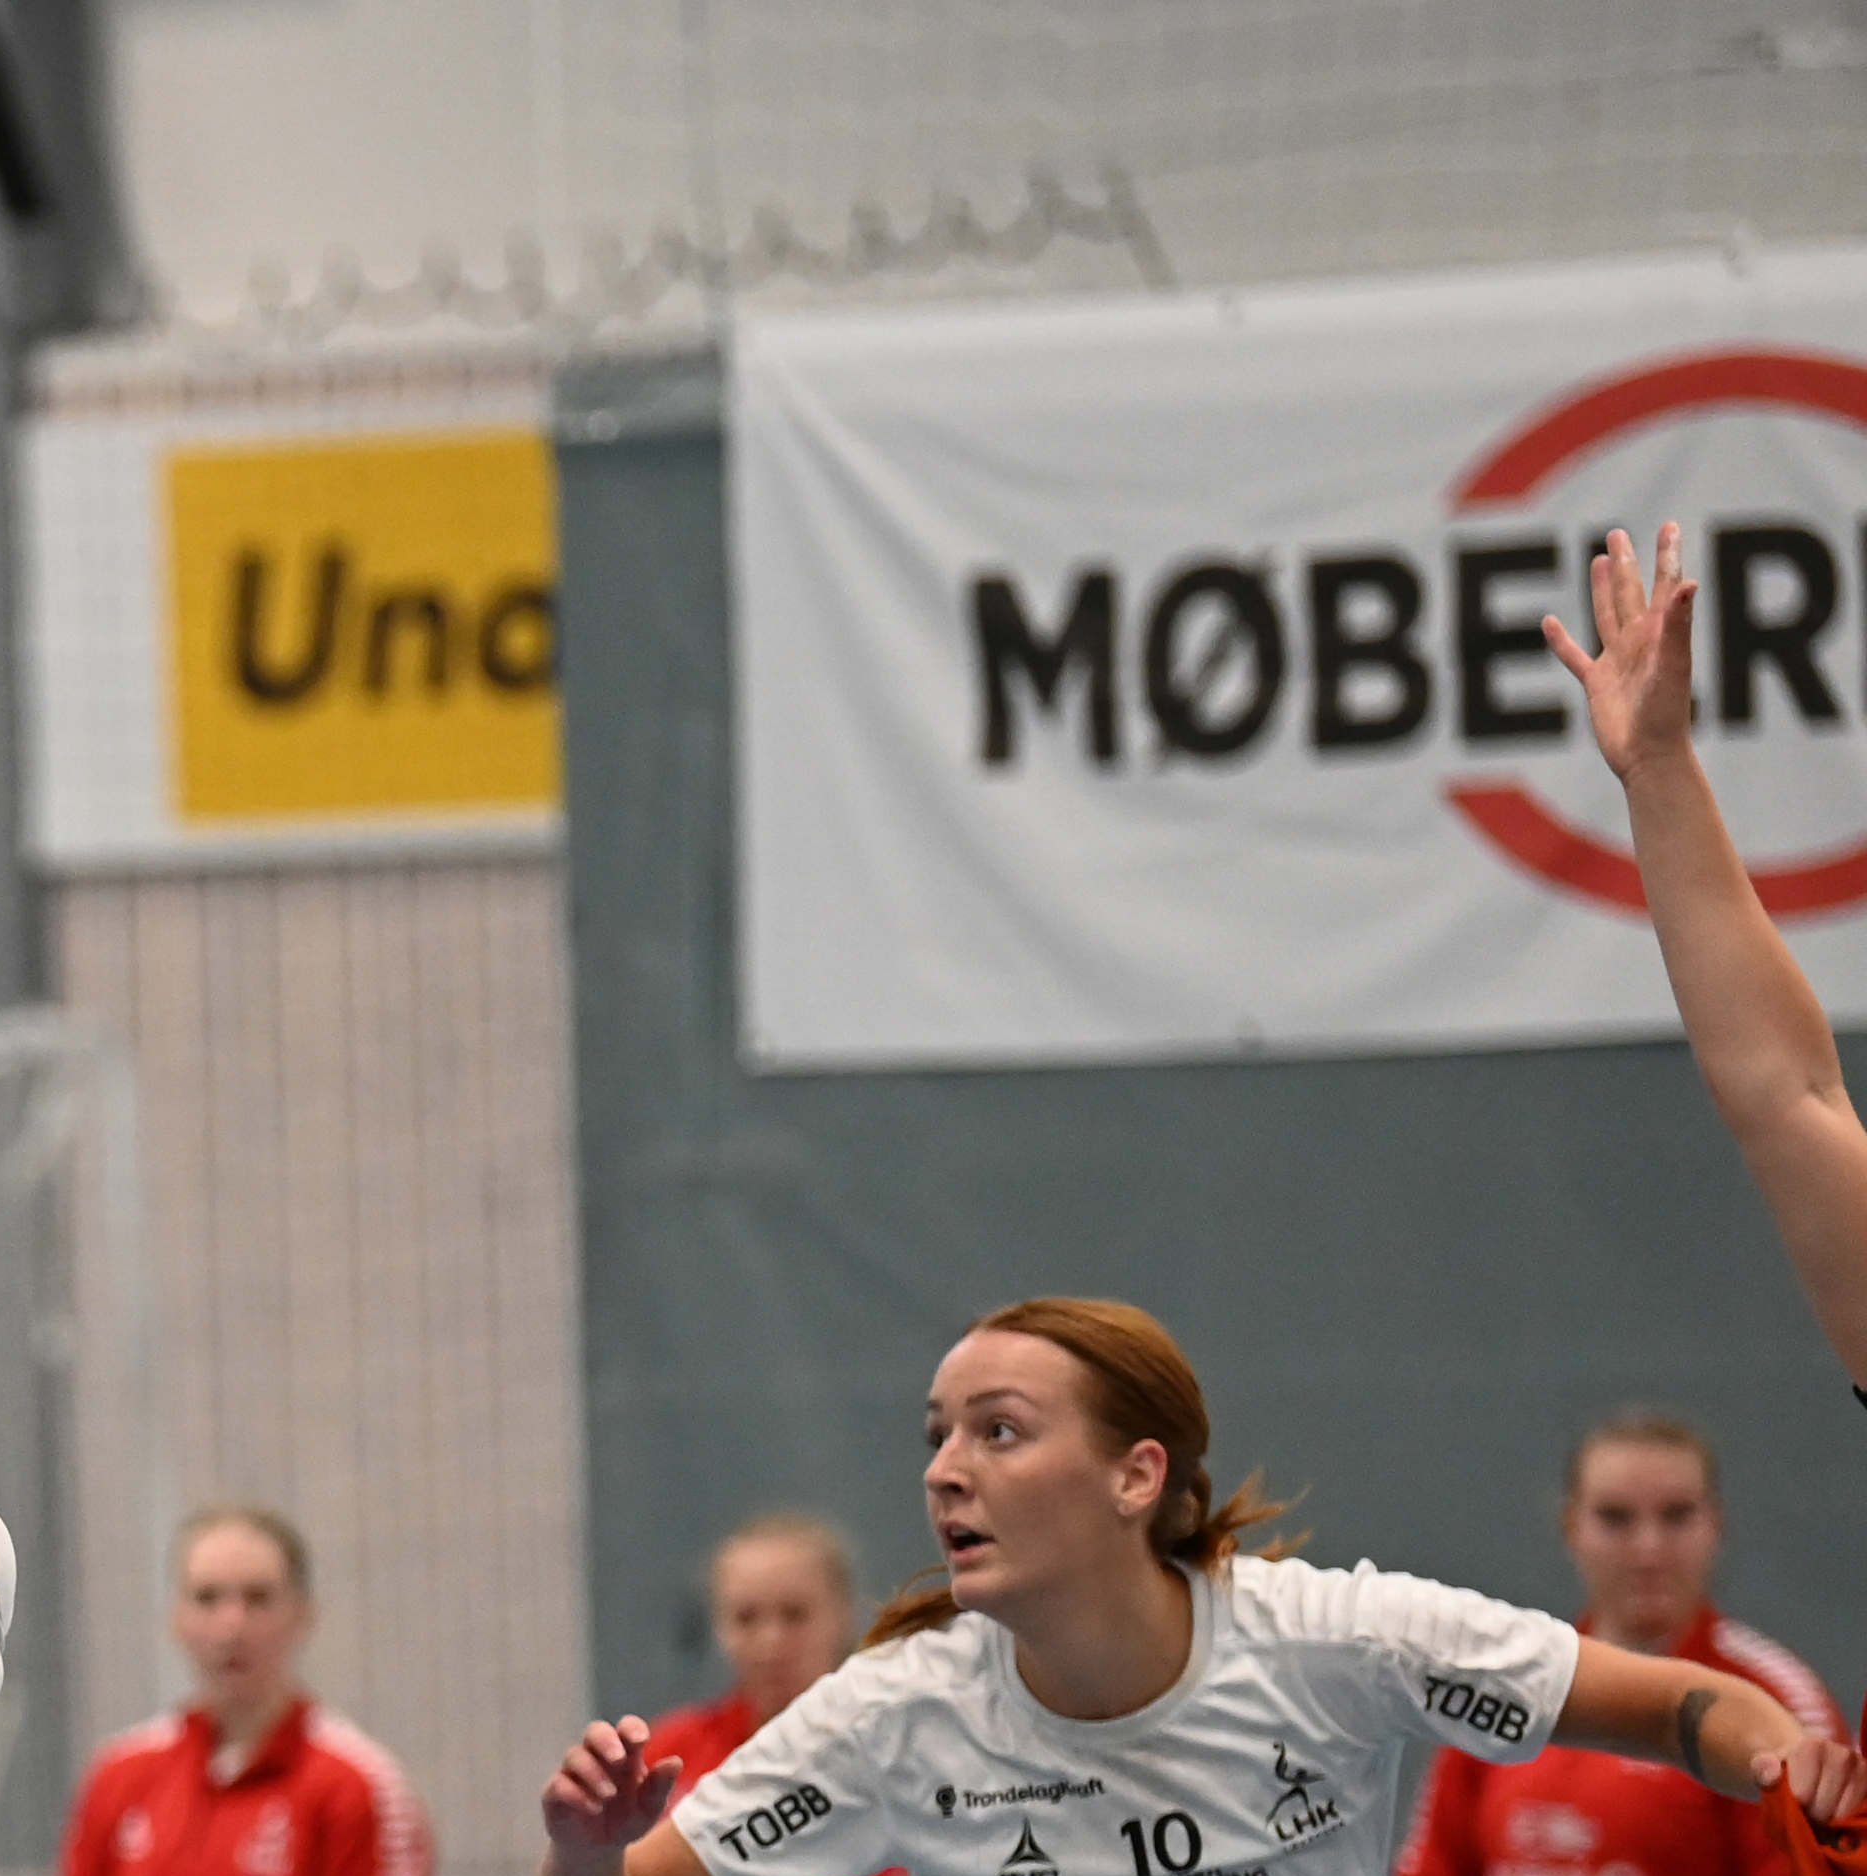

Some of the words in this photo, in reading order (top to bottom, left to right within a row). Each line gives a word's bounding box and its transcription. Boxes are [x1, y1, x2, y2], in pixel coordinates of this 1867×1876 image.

[970, 521, 1867, 768] MØBER
[1425, 1675, 1530, 1745] TOBB
[719, 1783, 833, 1862] TOBB
